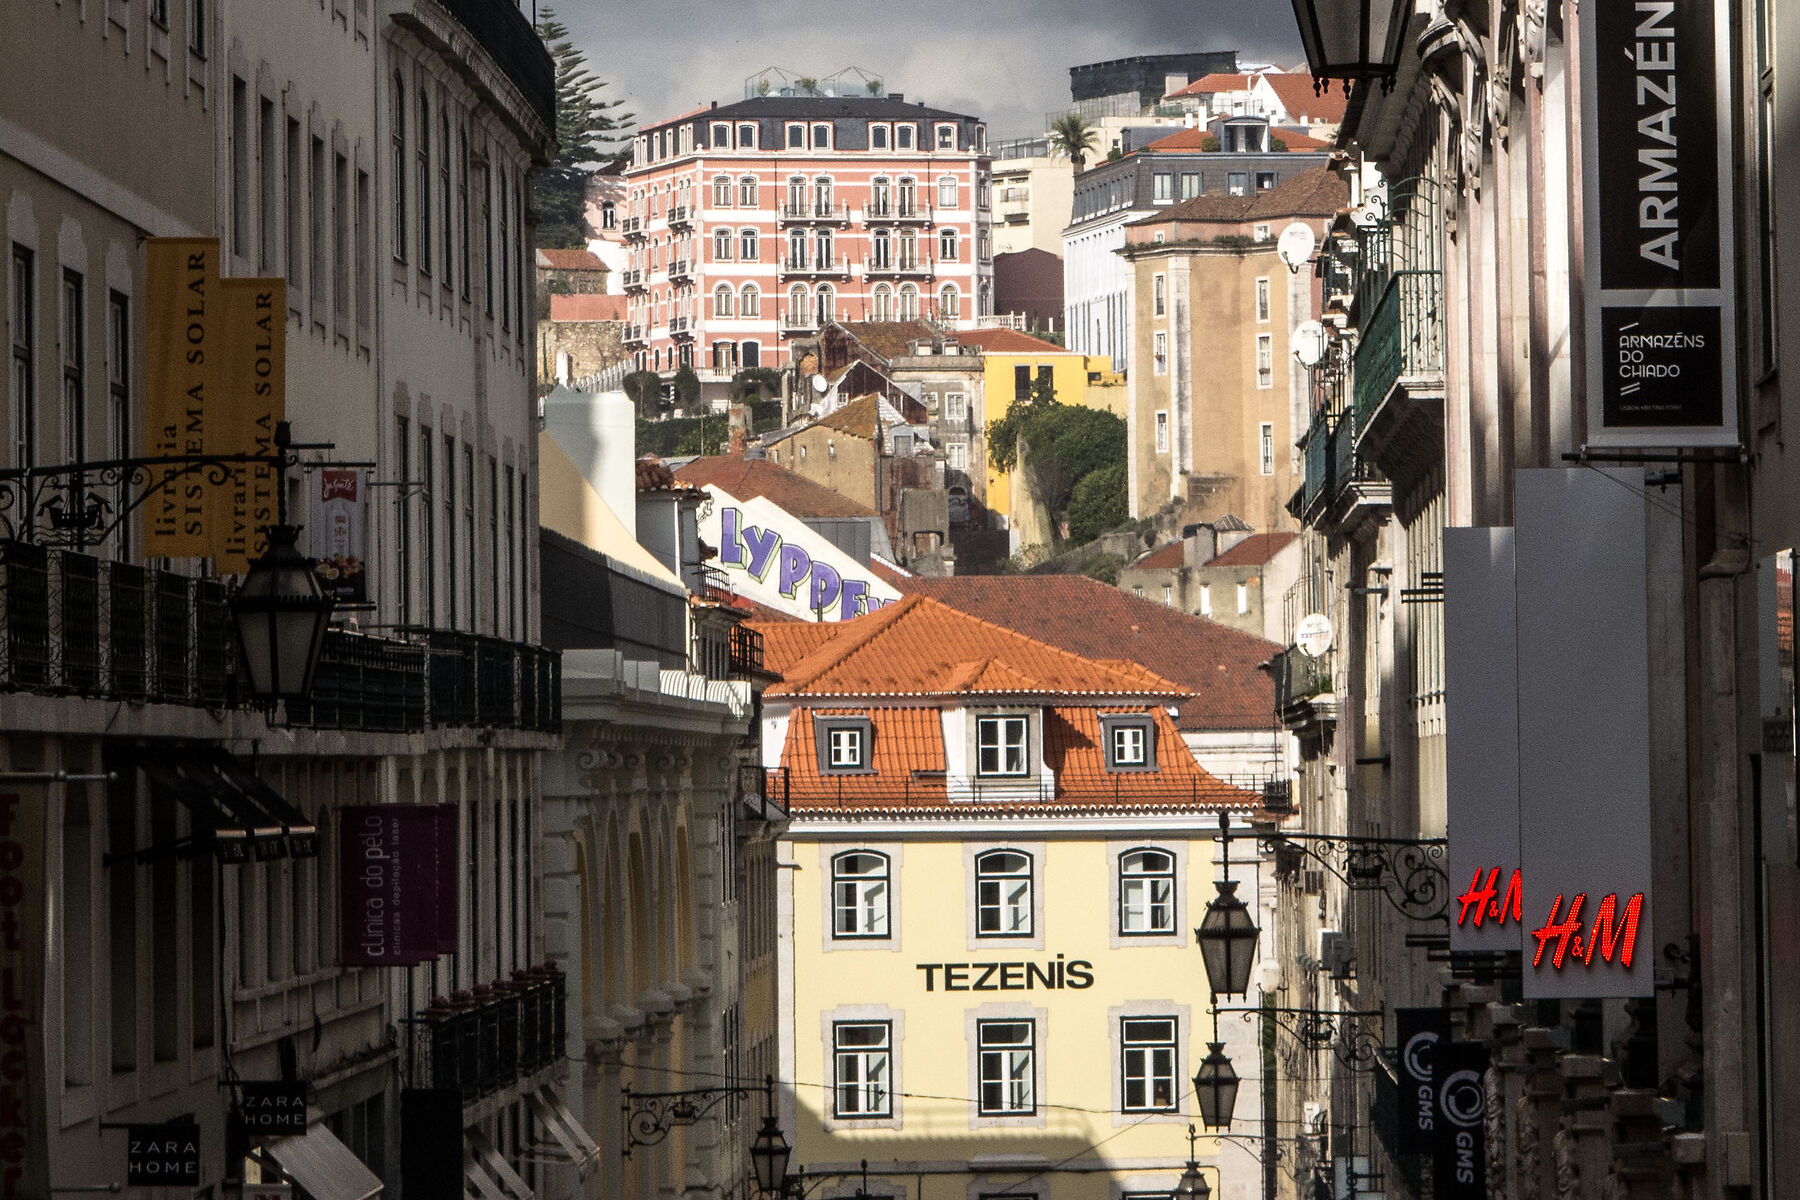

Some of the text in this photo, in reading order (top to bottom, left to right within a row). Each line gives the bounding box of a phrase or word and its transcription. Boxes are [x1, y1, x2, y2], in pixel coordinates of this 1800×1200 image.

[255, 290, 272, 397] SOLAR
[1619, 331, 1706, 349] ARMAZÉNS
[1619, 350, 1644, 363] DO
[1619, 364, 1681, 378] CHIADO
[184, 250, 205, 537] SISTEMA SOLAR
[154, 424, 177, 537] livraia
[361, 865, 384, 888] do
[360, 897, 385, 957] clínica
[1530, 891, 1645, 969] H&M
[244, 1095, 305, 1108] ZARA
[1417, 1084, 1434, 1131] GMS
[244, 1112, 305, 1126] HOME
[129, 1140, 197, 1154] ZARA
[1455, 1130, 1474, 1185] GMS
[128, 1160, 198, 1175] HOME
